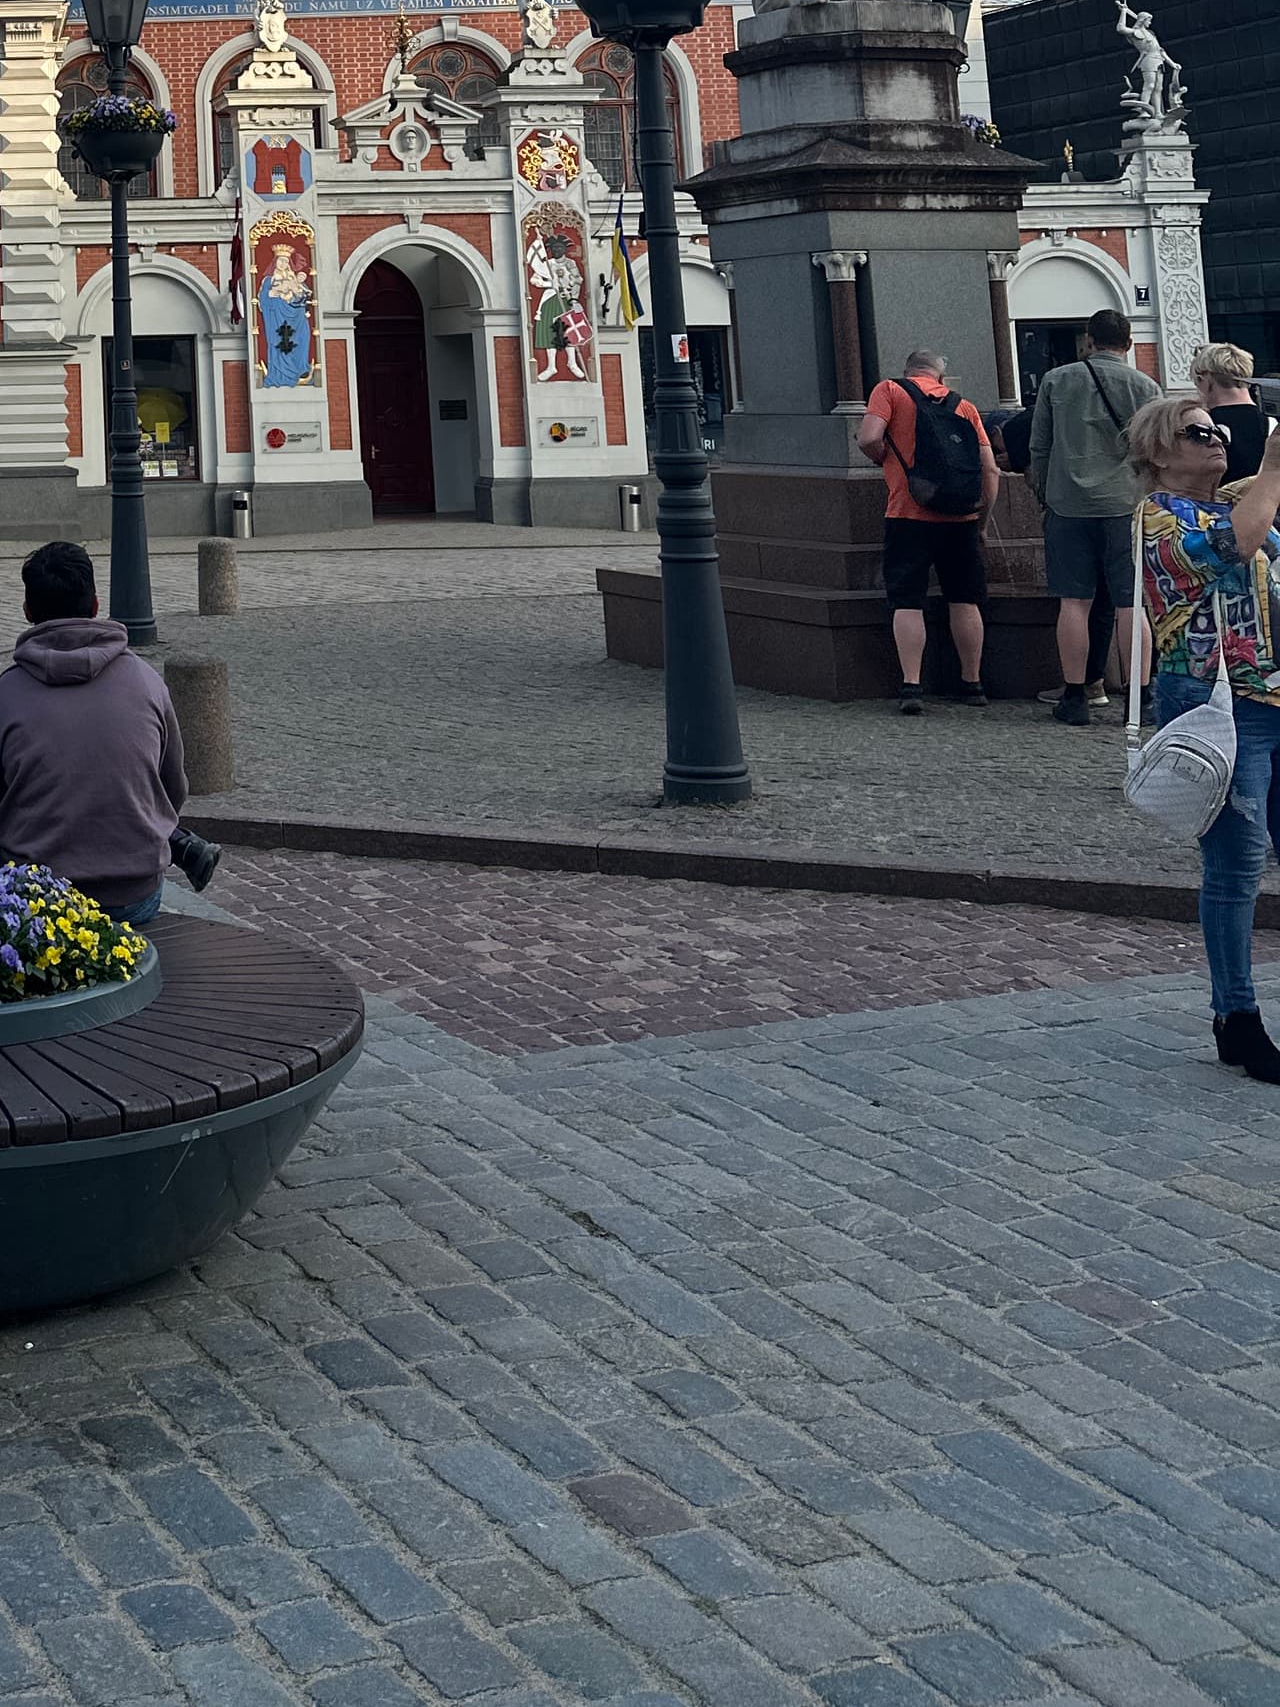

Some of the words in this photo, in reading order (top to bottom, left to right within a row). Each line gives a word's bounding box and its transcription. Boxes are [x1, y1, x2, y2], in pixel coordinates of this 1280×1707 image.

[309, 0, 349, 11] NAMU
[356, 0, 375, 10] UZ
[1139, 289, 1146, 299] 7
